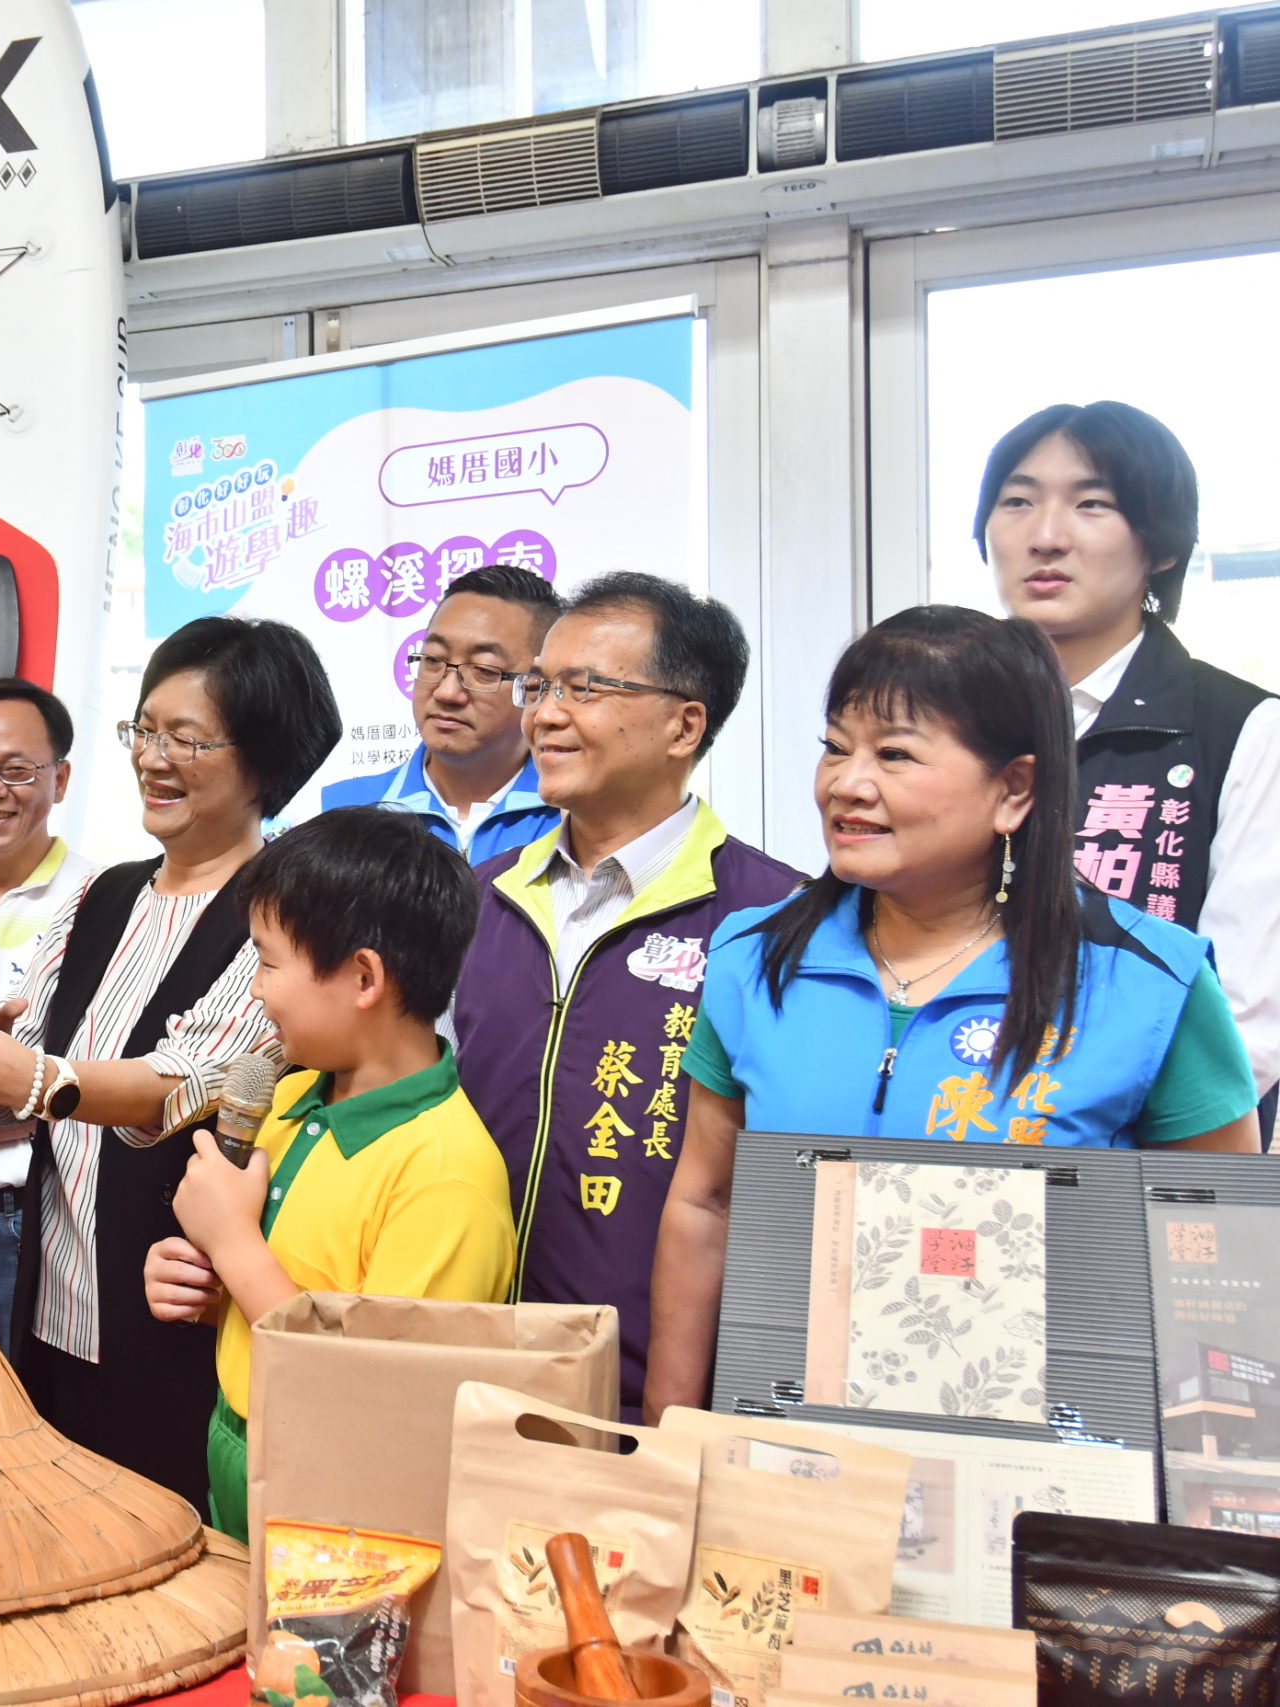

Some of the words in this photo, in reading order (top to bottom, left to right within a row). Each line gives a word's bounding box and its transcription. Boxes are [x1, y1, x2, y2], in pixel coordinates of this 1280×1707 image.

[783, 182, 816, 193] TECO
[428, 442, 558, 488] 媽厝國小
[1073, 784, 1156, 900] 黃柏
[1146, 798, 1191, 921] 彰化縣議
[579, 1040, 644, 1216] 蔡金田
[642, 1002, 696, 1160] 教育處長
[925, 1071, 998, 1142] 陳
